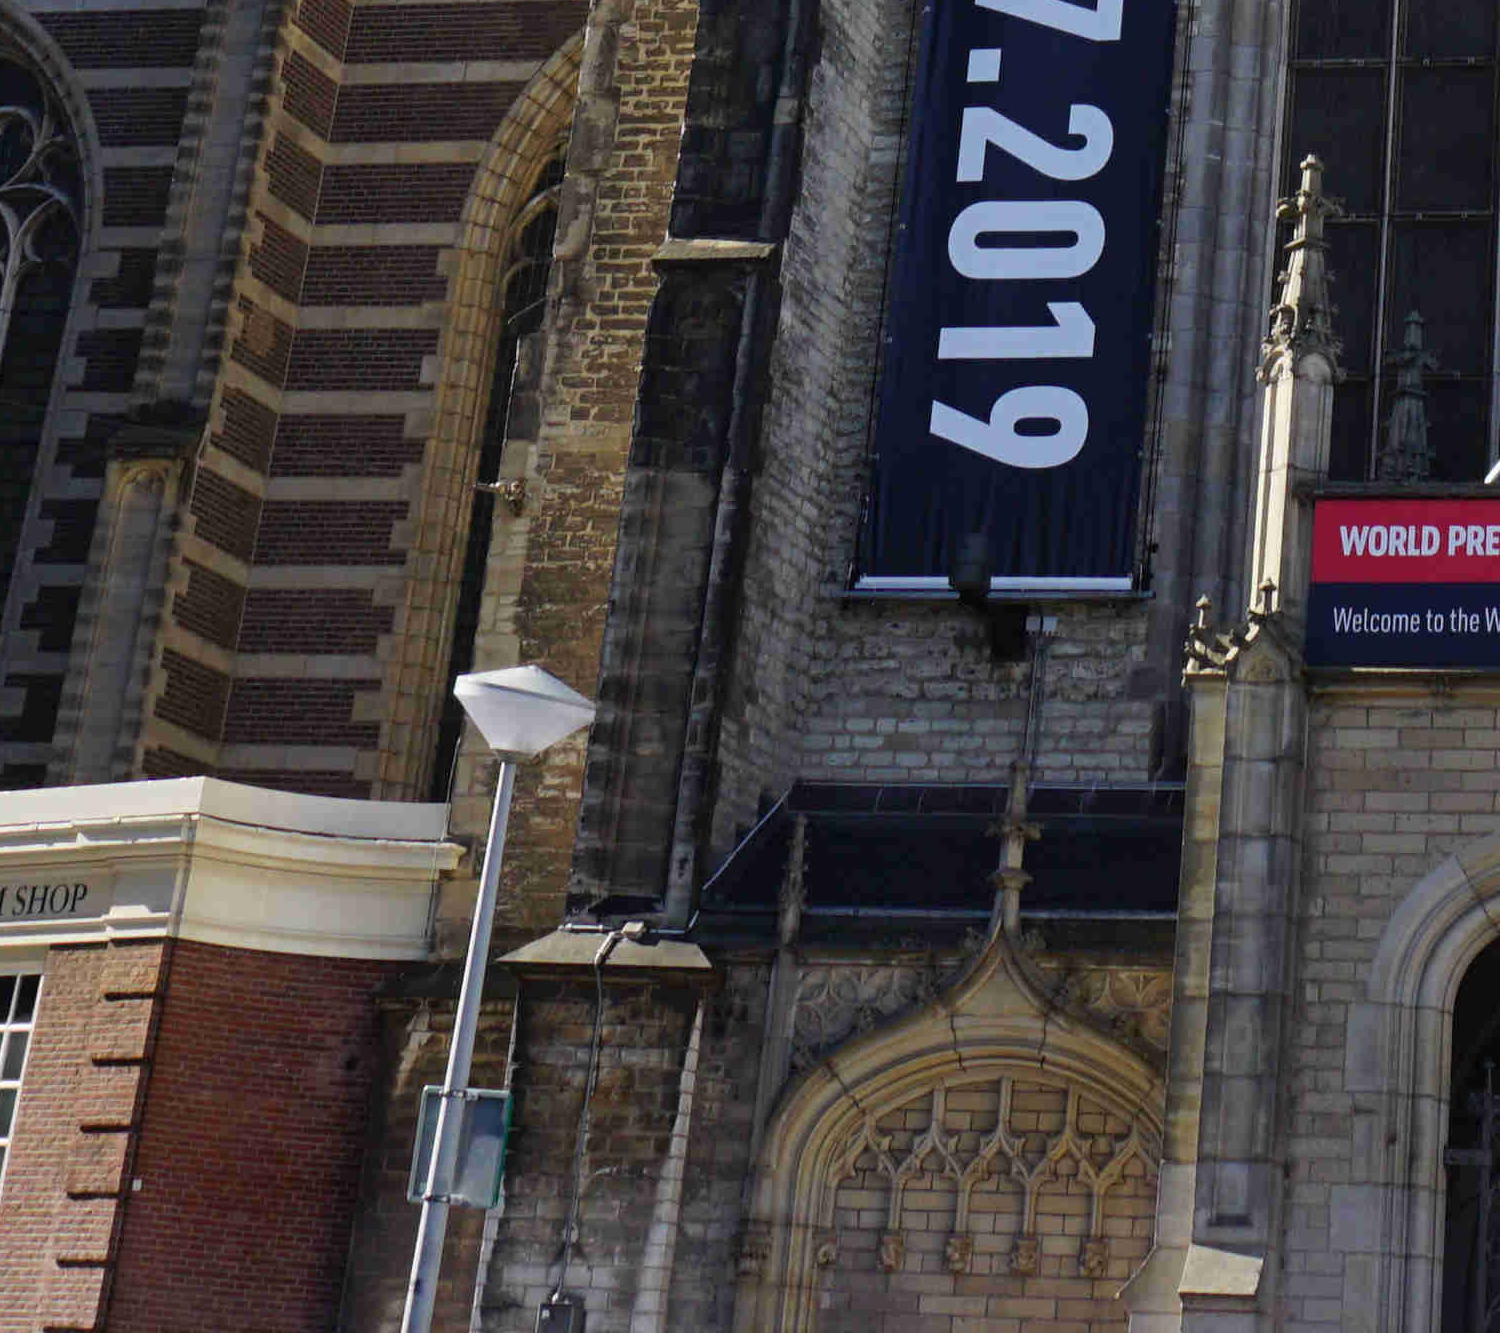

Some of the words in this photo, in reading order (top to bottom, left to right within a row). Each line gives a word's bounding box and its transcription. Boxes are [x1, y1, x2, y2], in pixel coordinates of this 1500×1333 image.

[1339, 524, 1440, 556] WORLD
[1332, 607, 1421, 633] Welcome
[1426, 608, 1445, 633] to
[1450, 607, 1480, 633] the
[11, 883, 89, 917] SHOP
